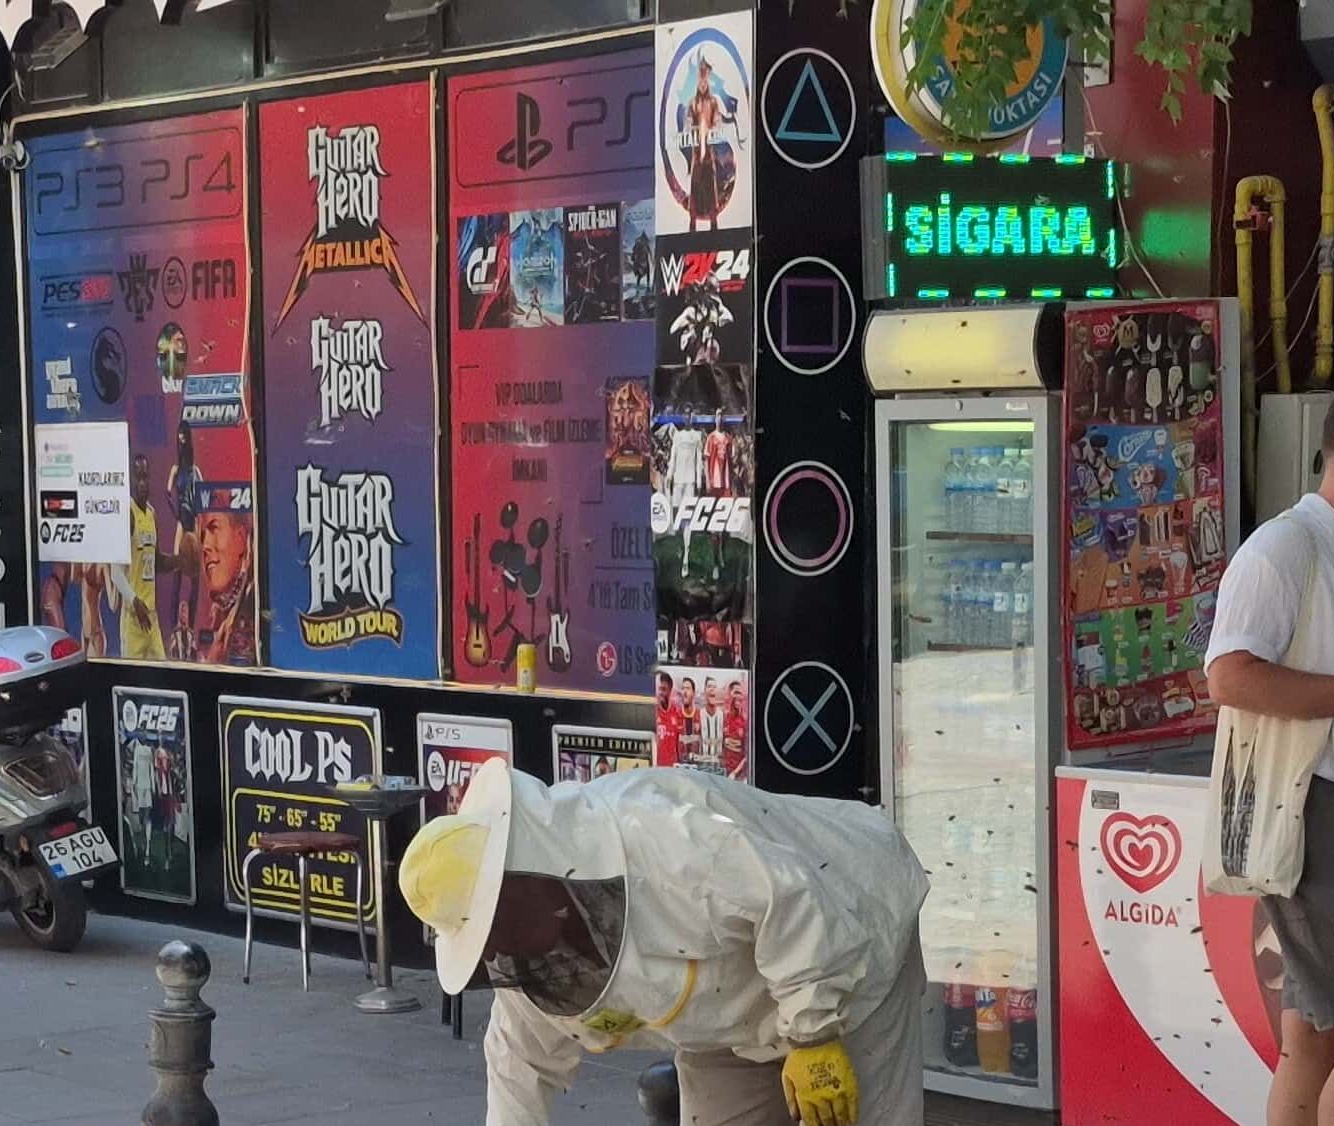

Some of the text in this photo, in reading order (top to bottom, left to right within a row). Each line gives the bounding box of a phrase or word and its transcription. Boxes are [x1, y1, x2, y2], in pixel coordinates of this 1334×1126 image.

[37, 152, 236, 216] PS3 PS4
[905, 193, 1095, 255] SİGARA
[192, 259, 236, 301] FIFA
[182, 404, 240, 421] DOWN
[303, 610, 399, 645] WORLD TOUR
[244, 720, 352, 784] COOL PS
[43, 829, 105, 861] 26 AGU
[72, 850, 103, 870] 104
[261, 863, 345, 897] SİZLRLE
